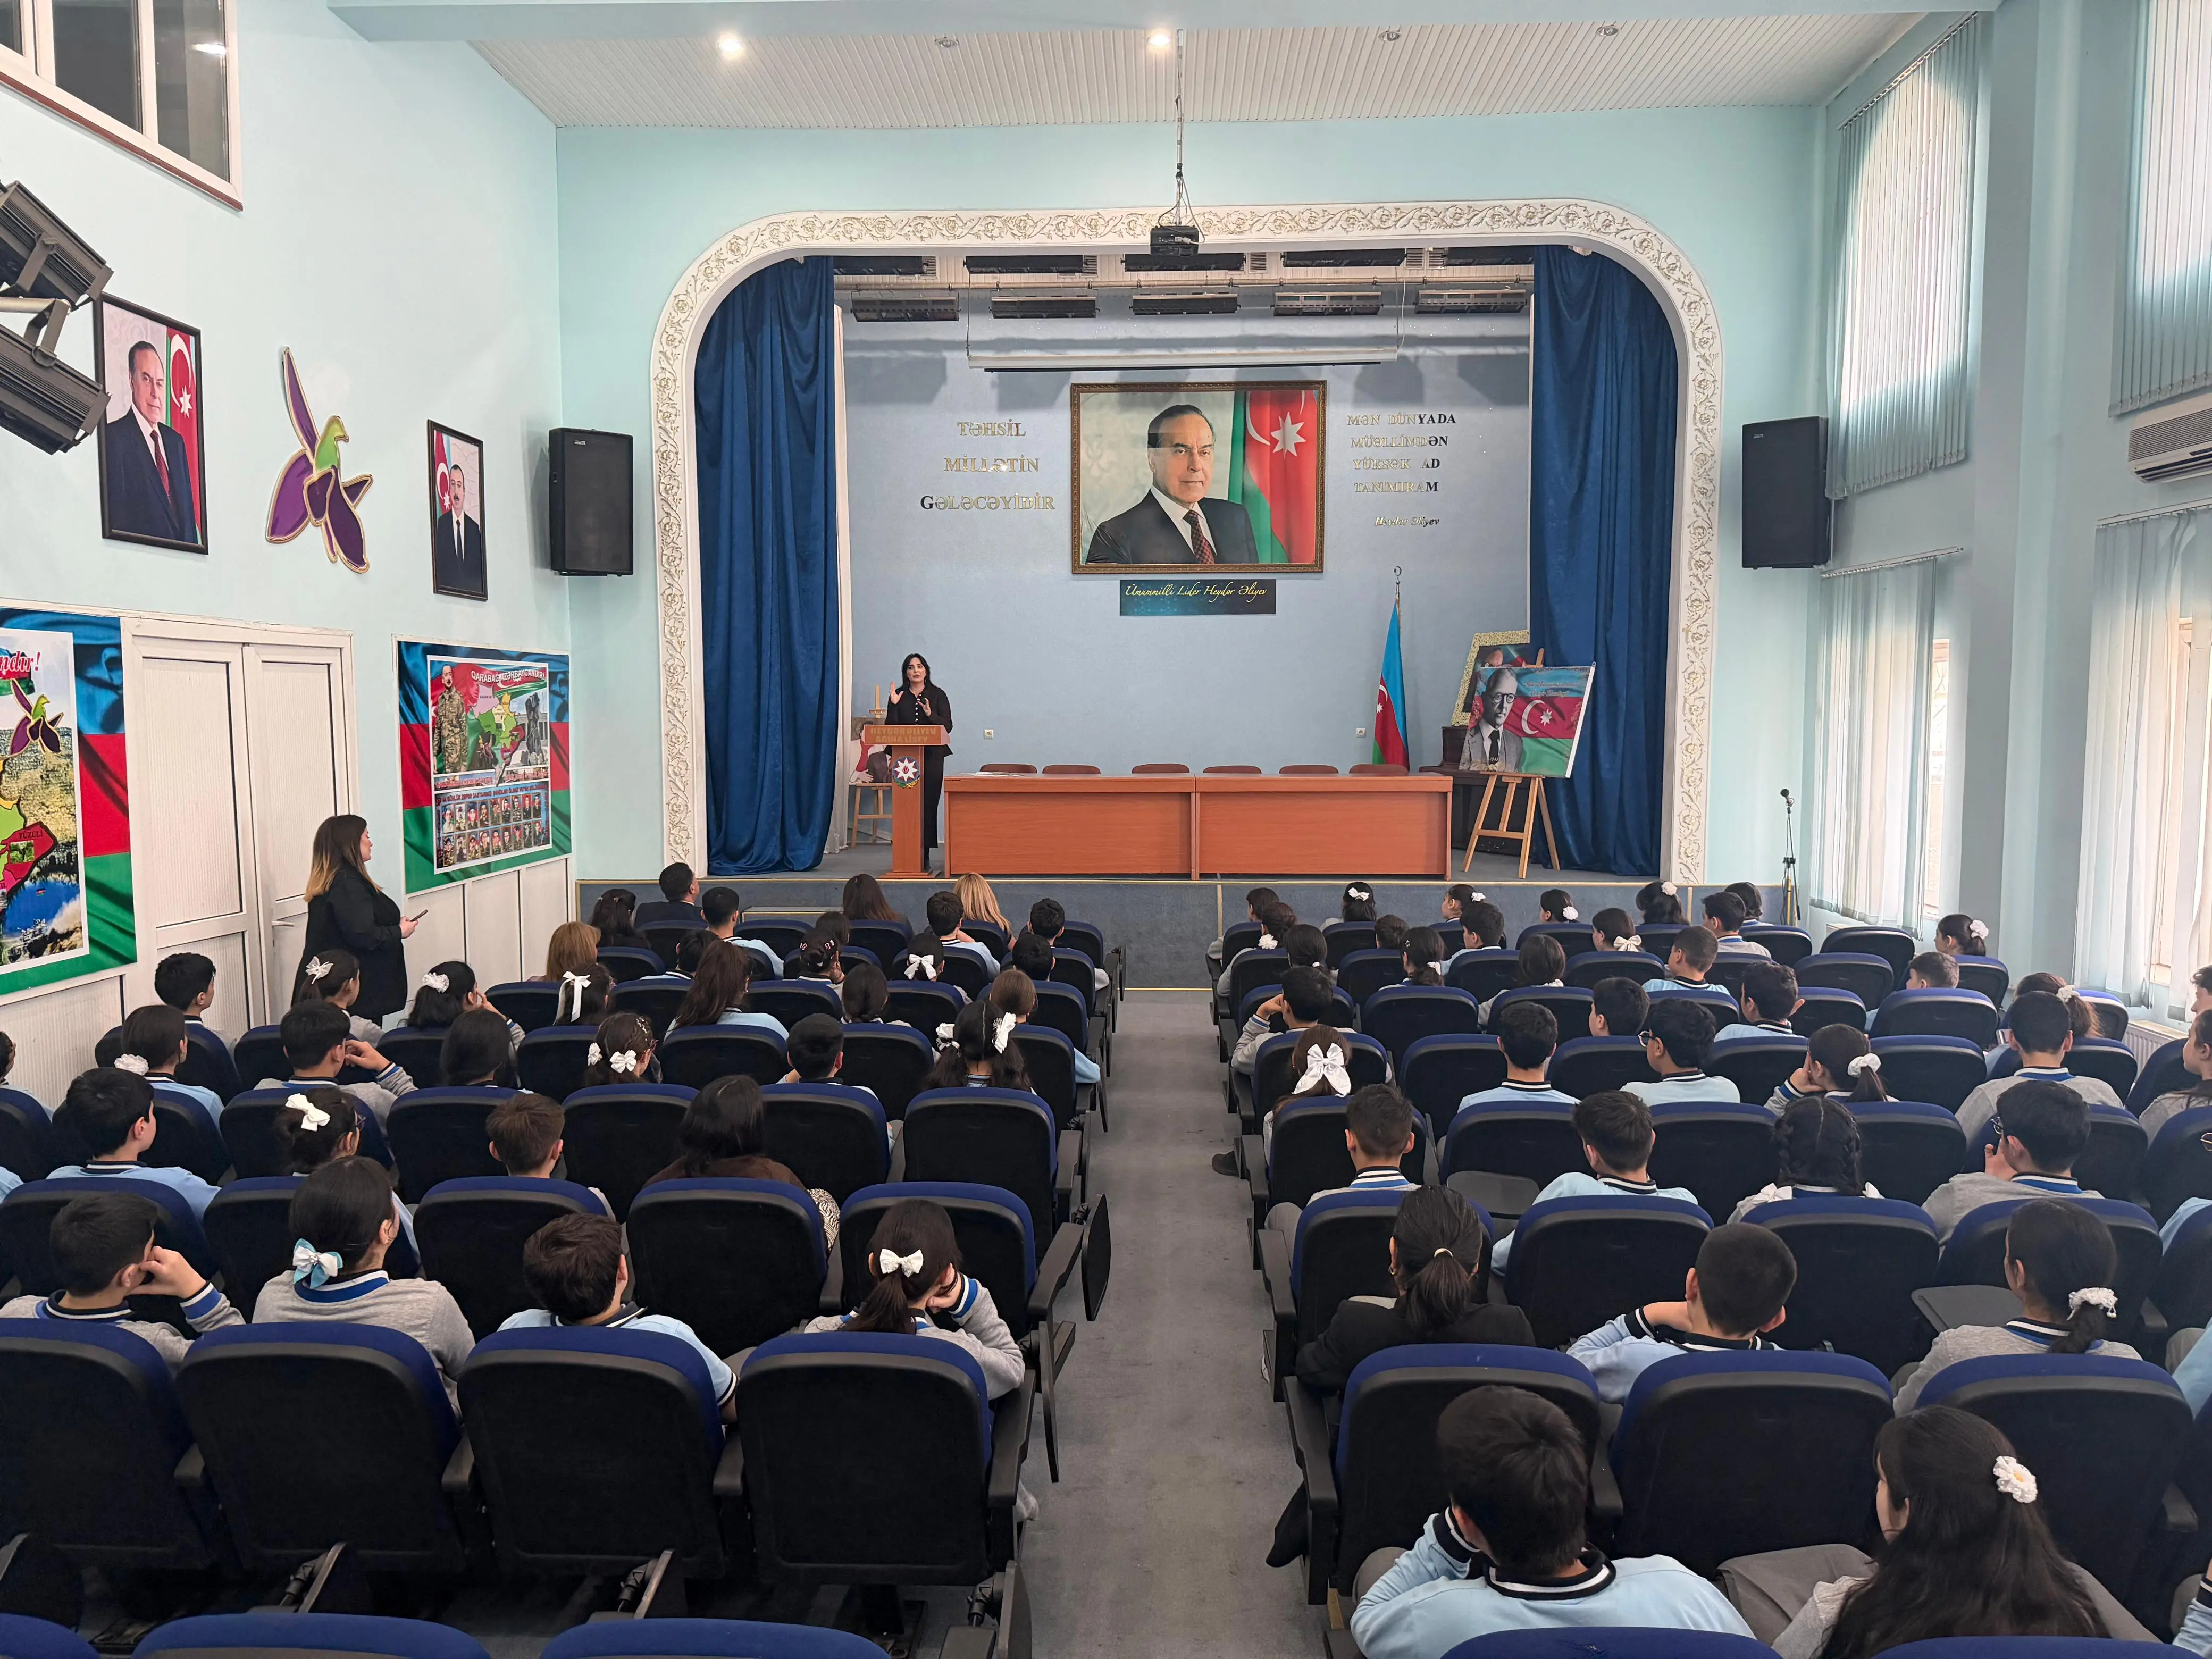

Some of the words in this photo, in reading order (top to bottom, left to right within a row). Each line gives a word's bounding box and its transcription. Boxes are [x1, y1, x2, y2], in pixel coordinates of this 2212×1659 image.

[1347, 415, 1381, 425] MƏN
[1387, 412, 1456, 425] DÜNYADA
[957, 418, 1026, 437] TƏHSİL
[1351, 434, 1448, 448] MÜƏLLİMDƏN
[944, 454, 1039, 472] MİLLƏTİN
[1353, 456, 1411, 470] YÜKSƏK
[1420, 458, 1440, 469] AD
[1354, 482, 1439, 493] TANIMIRAM
[920, 492, 1055, 510] GƏLƏCƏYİDİR
[1177, 581, 1201, 597] Lider
[1238, 581, 1268, 603] Əliyev
